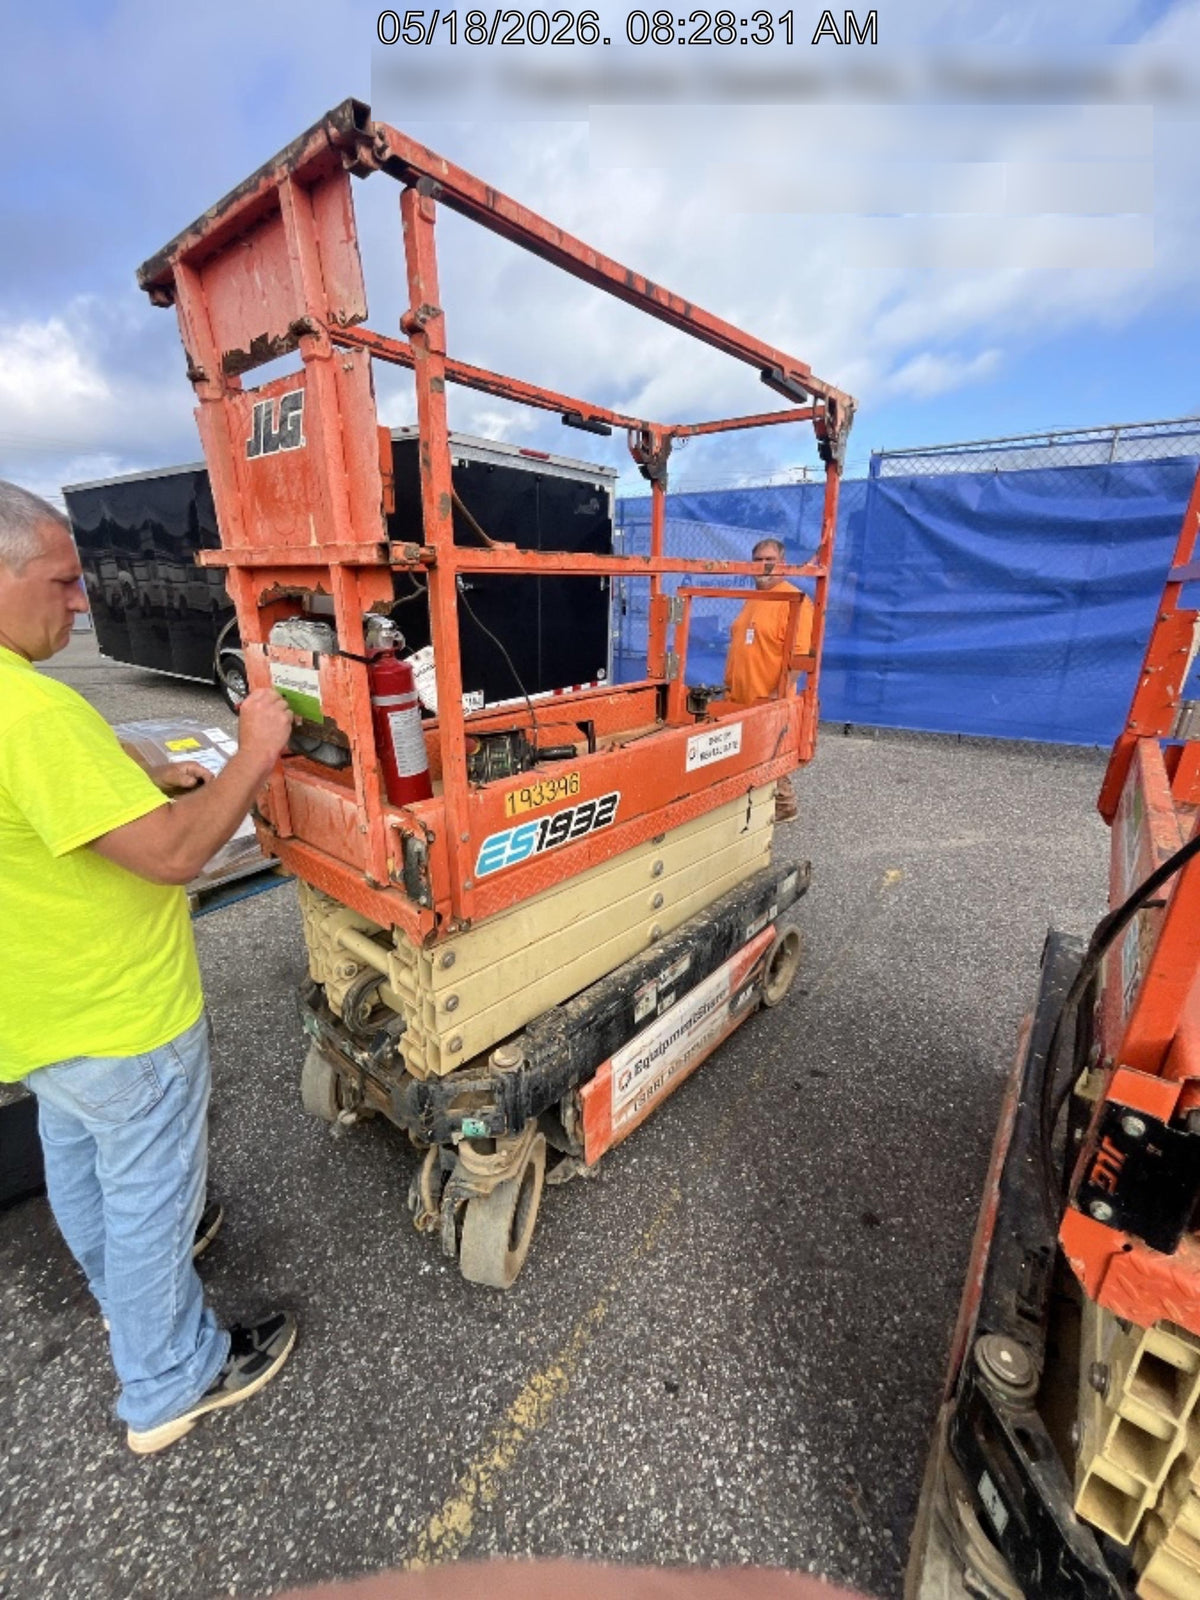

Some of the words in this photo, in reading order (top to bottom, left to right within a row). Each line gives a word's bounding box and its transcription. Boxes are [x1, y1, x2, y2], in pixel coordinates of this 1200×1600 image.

[246, 387, 305, 460] JLG
[508, 772, 580, 814] 193396
[476, 792, 620, 877] ES1932
[1090, 1136, 1127, 1194] JLG
